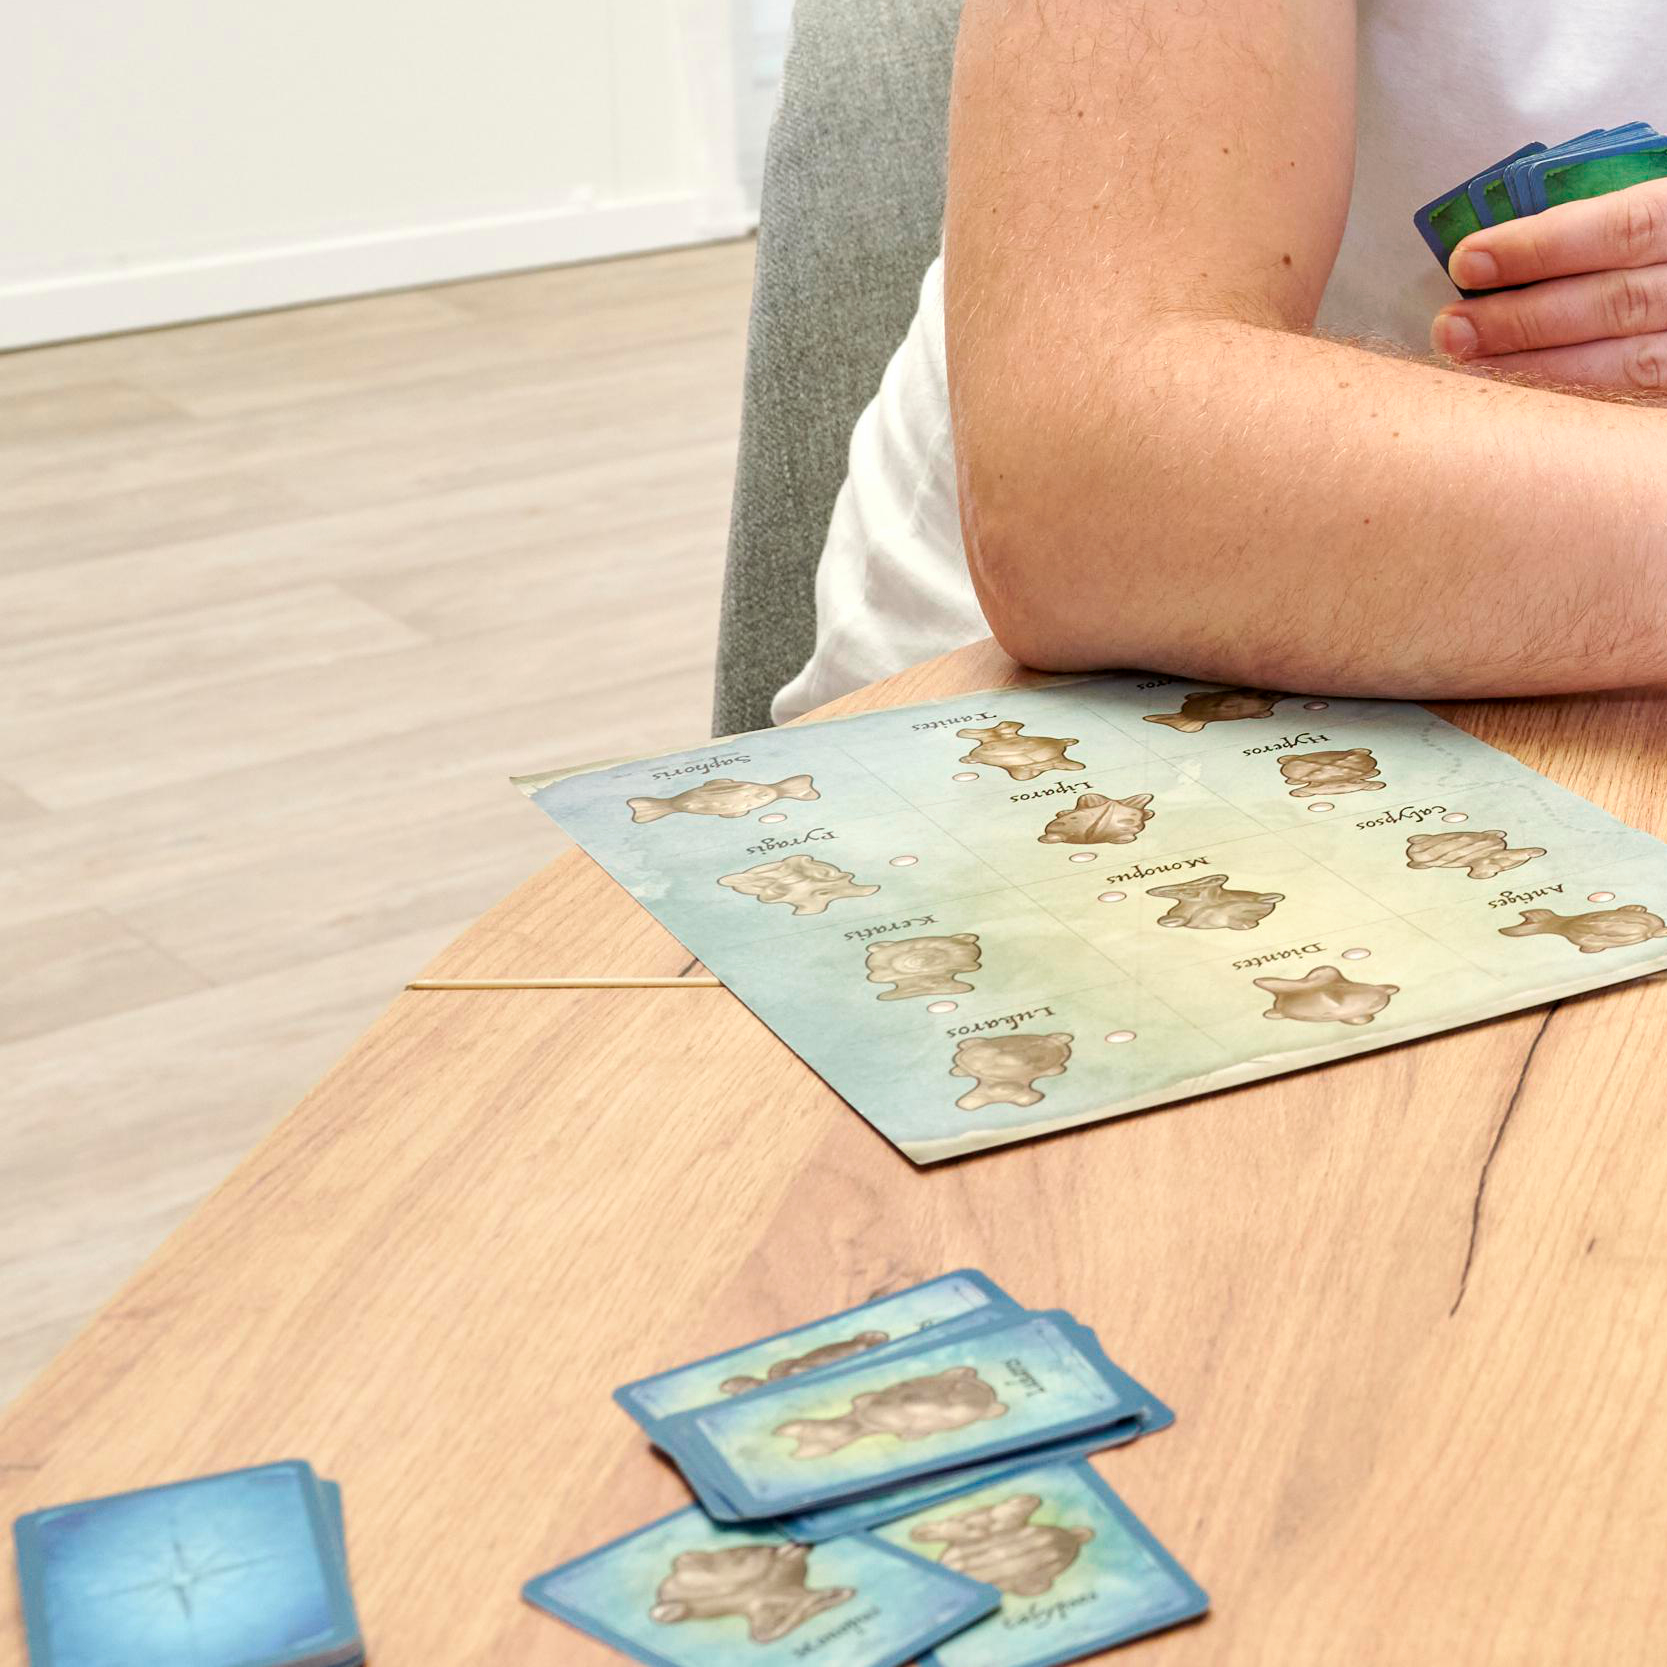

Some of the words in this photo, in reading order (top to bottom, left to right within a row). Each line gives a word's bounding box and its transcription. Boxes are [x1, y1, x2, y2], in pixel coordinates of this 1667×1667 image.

[911, 712, 998, 732] Tanites
[1243, 732, 1330, 756] Hyperos
[653, 755, 751, 780] Saphoris
[1010, 782, 1093, 804] Liparos
[1356, 806, 1446, 831] Calypsos
[746, 827, 838, 855] Pyragis
[1107, 857, 1210, 884] Monopus
[1488, 884, 1564, 908] Antiges
[844, 915, 940, 941] Keratis
[1233, 943, 1328, 970] Diantes
